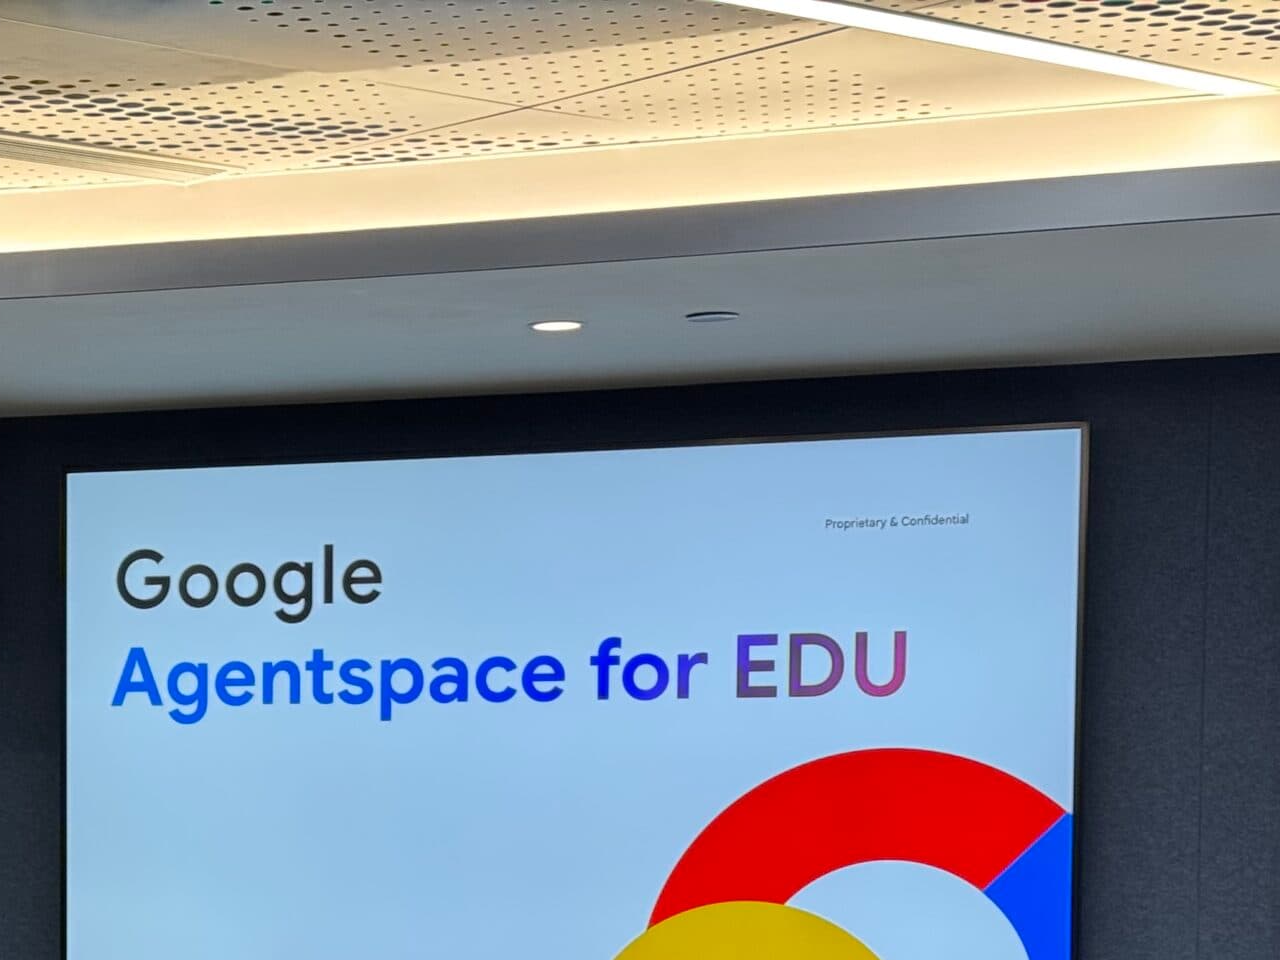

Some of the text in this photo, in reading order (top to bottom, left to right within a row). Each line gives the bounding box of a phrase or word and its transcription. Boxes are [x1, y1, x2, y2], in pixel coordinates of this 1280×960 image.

[825, 513, 969, 531] Proprietary & Confidential
[116, 544, 382, 624] Google
[111, 630, 907, 725] Agentspace for EDU
